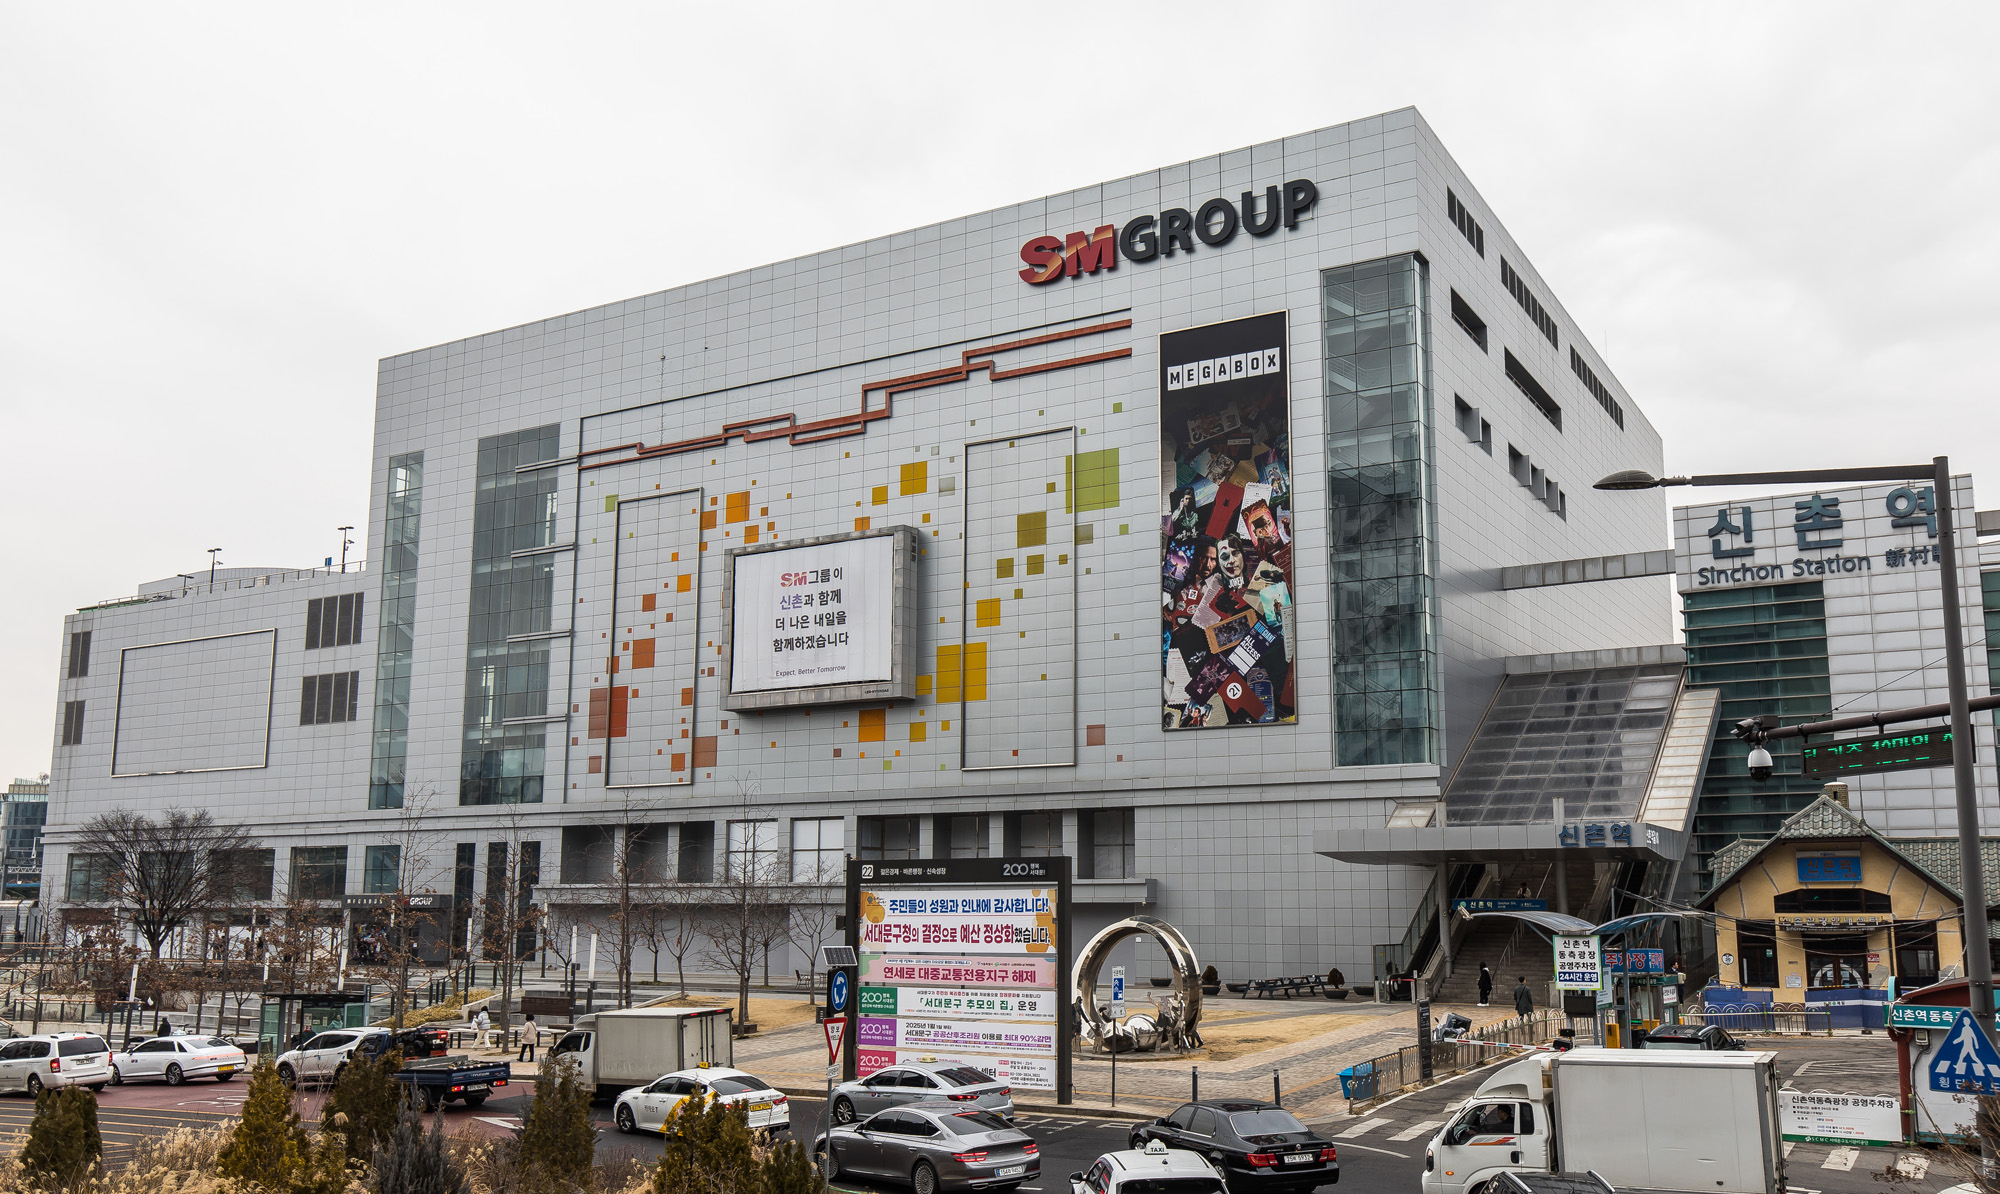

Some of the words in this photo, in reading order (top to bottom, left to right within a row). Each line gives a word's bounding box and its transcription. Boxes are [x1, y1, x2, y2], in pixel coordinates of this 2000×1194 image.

[1169, 350, 1279, 388] MEGABOX
[1708, 486, 1939, 559] 신촌역
[1698, 562, 1784, 586] Sinchon
[1792, 553, 1872, 577] Station
[780, 593, 814, 610] 신촌과
[818, 588, 842, 606] 함께
[775, 617, 785, 631] 더
[789, 614, 810, 629] 나은
[814, 610, 847, 627] 내일을
[772, 631, 849, 652] 함께하겠습니다
[1244, 635, 1256, 646] ALL
[1240, 640, 1261, 661] ACCESS
[816, 664, 846, 673] Tomorrow
[1228, 684, 1242, 698] 21
[1559, 823, 1632, 847] 신촌역
[862, 866, 873, 877] 22
[1003, 863, 1029, 876] 200
[1807, 859, 1852, 873] 신촌역
[889, 898, 927, 914] 주민들의
[929, 898, 959, 914] 성원과
[962, 898, 991, 913] 인내에
[994, 897, 1049, 913] 감사합니다!
[1470, 901, 1493, 909] 신촌역
[1782, 916, 1880, 926] 신촌관광안내센터
[864, 924, 920, 944] 서대문구청의
[922, 924, 958, 944] 결정으로
[960, 924, 981, 944] 예산
[983, 924, 1051, 944] 정상화했습니다.
[1562, 939, 1592, 949] 신촌역
[1558, 950, 1596, 960] 동측광장
[1558, 961, 1597, 971] 공영주차장
[883, 966, 916, 980] 연세로
[918, 967, 1009, 982] 대중교통전용지구
[1011, 969, 1037, 983] 해제
[1559, 972, 1583, 982] 24시간
[1584, 972, 1599, 982] 운영
[861, 992, 882, 1004] 200
[967, 999, 995, 1009] 추모의
[1018, 1001, 1037, 1011] 운영
[830, 1025, 840, 1033] 양보
[860, 1023, 881, 1034] 200
[982, 1033, 1003, 1041] 이용료
[860, 1055, 881, 1067] 200
[1791, 1095, 1849, 1106] 신촌역동측광장
[1852, 1098, 1895, 1108] 공영주차장
